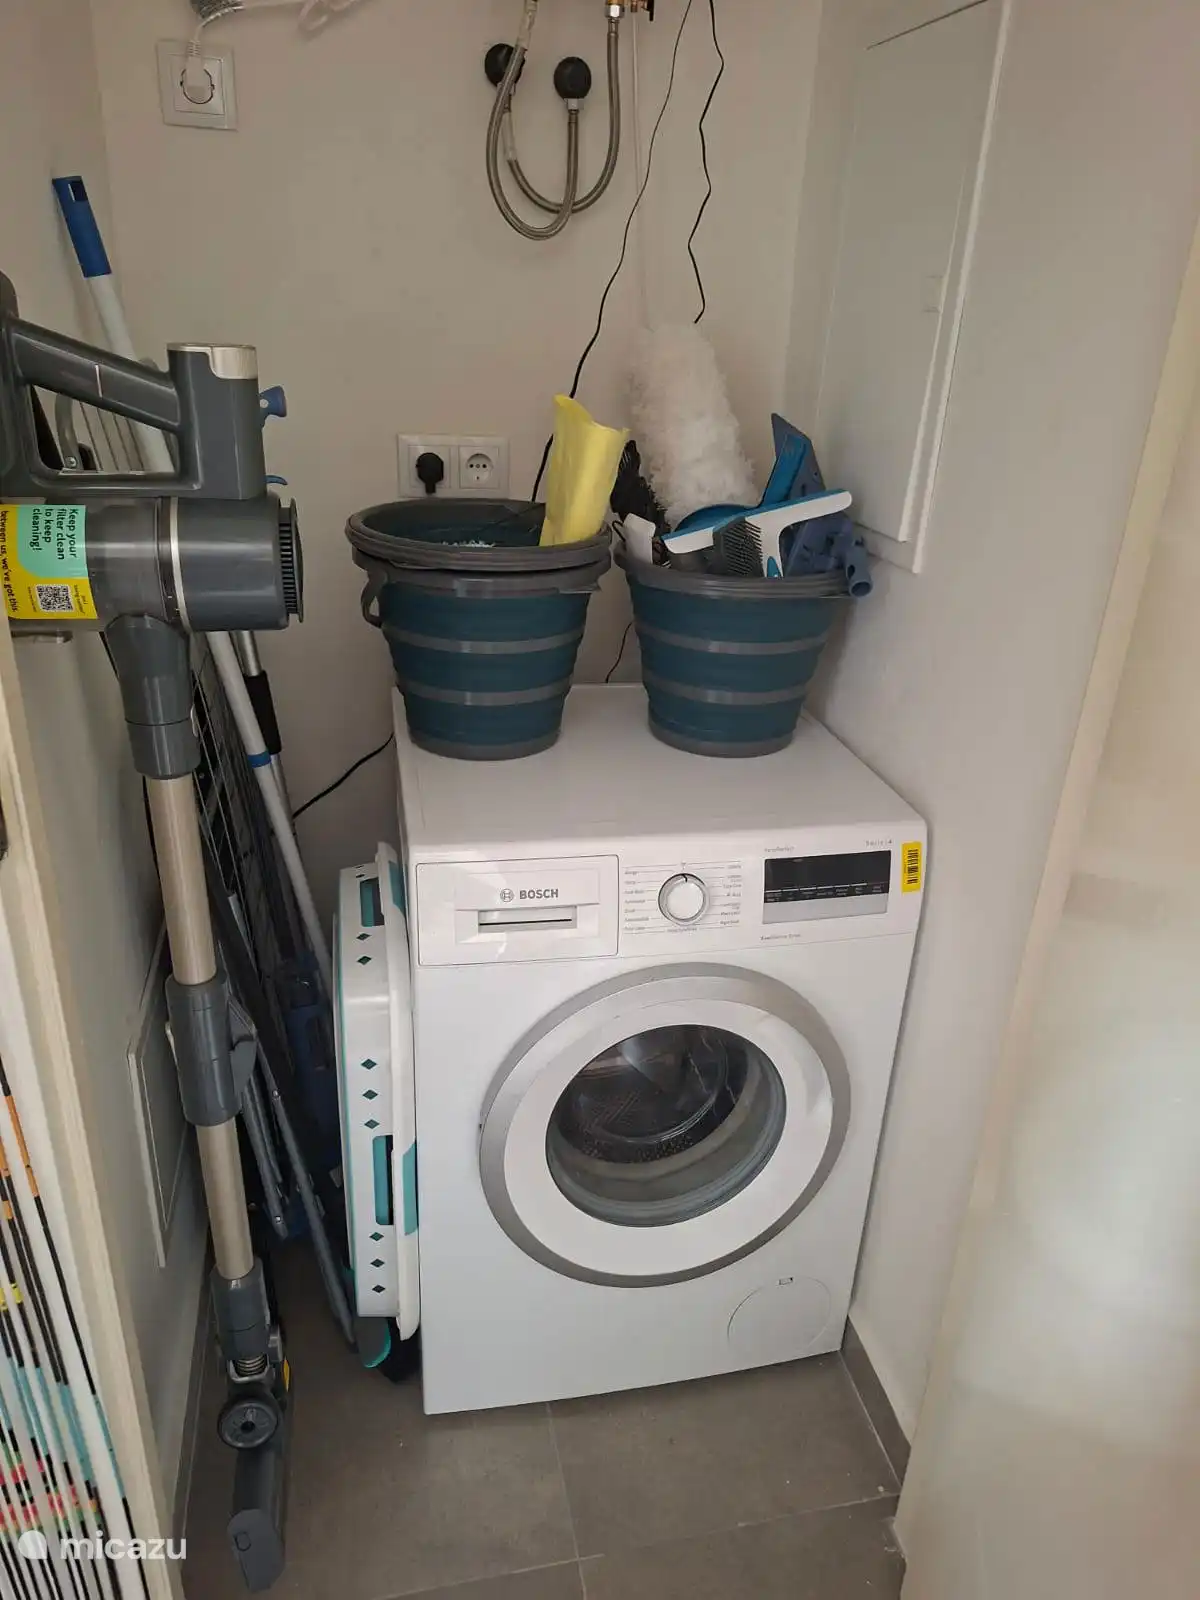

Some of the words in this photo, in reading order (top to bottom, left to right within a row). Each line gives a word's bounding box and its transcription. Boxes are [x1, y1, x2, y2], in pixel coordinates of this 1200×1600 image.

[44, 508, 54, 517] to
[56, 508, 67, 530] filter
[66, 508, 79, 531] Keep
[29, 508, 42, 551] cleaning!
[42, 519, 54, 543] keep
[56, 532, 67, 560] clean
[66, 532, 77, 558] your
[4, 583, 14, 597] got
[519, 889, 559, 900] BOSCH
